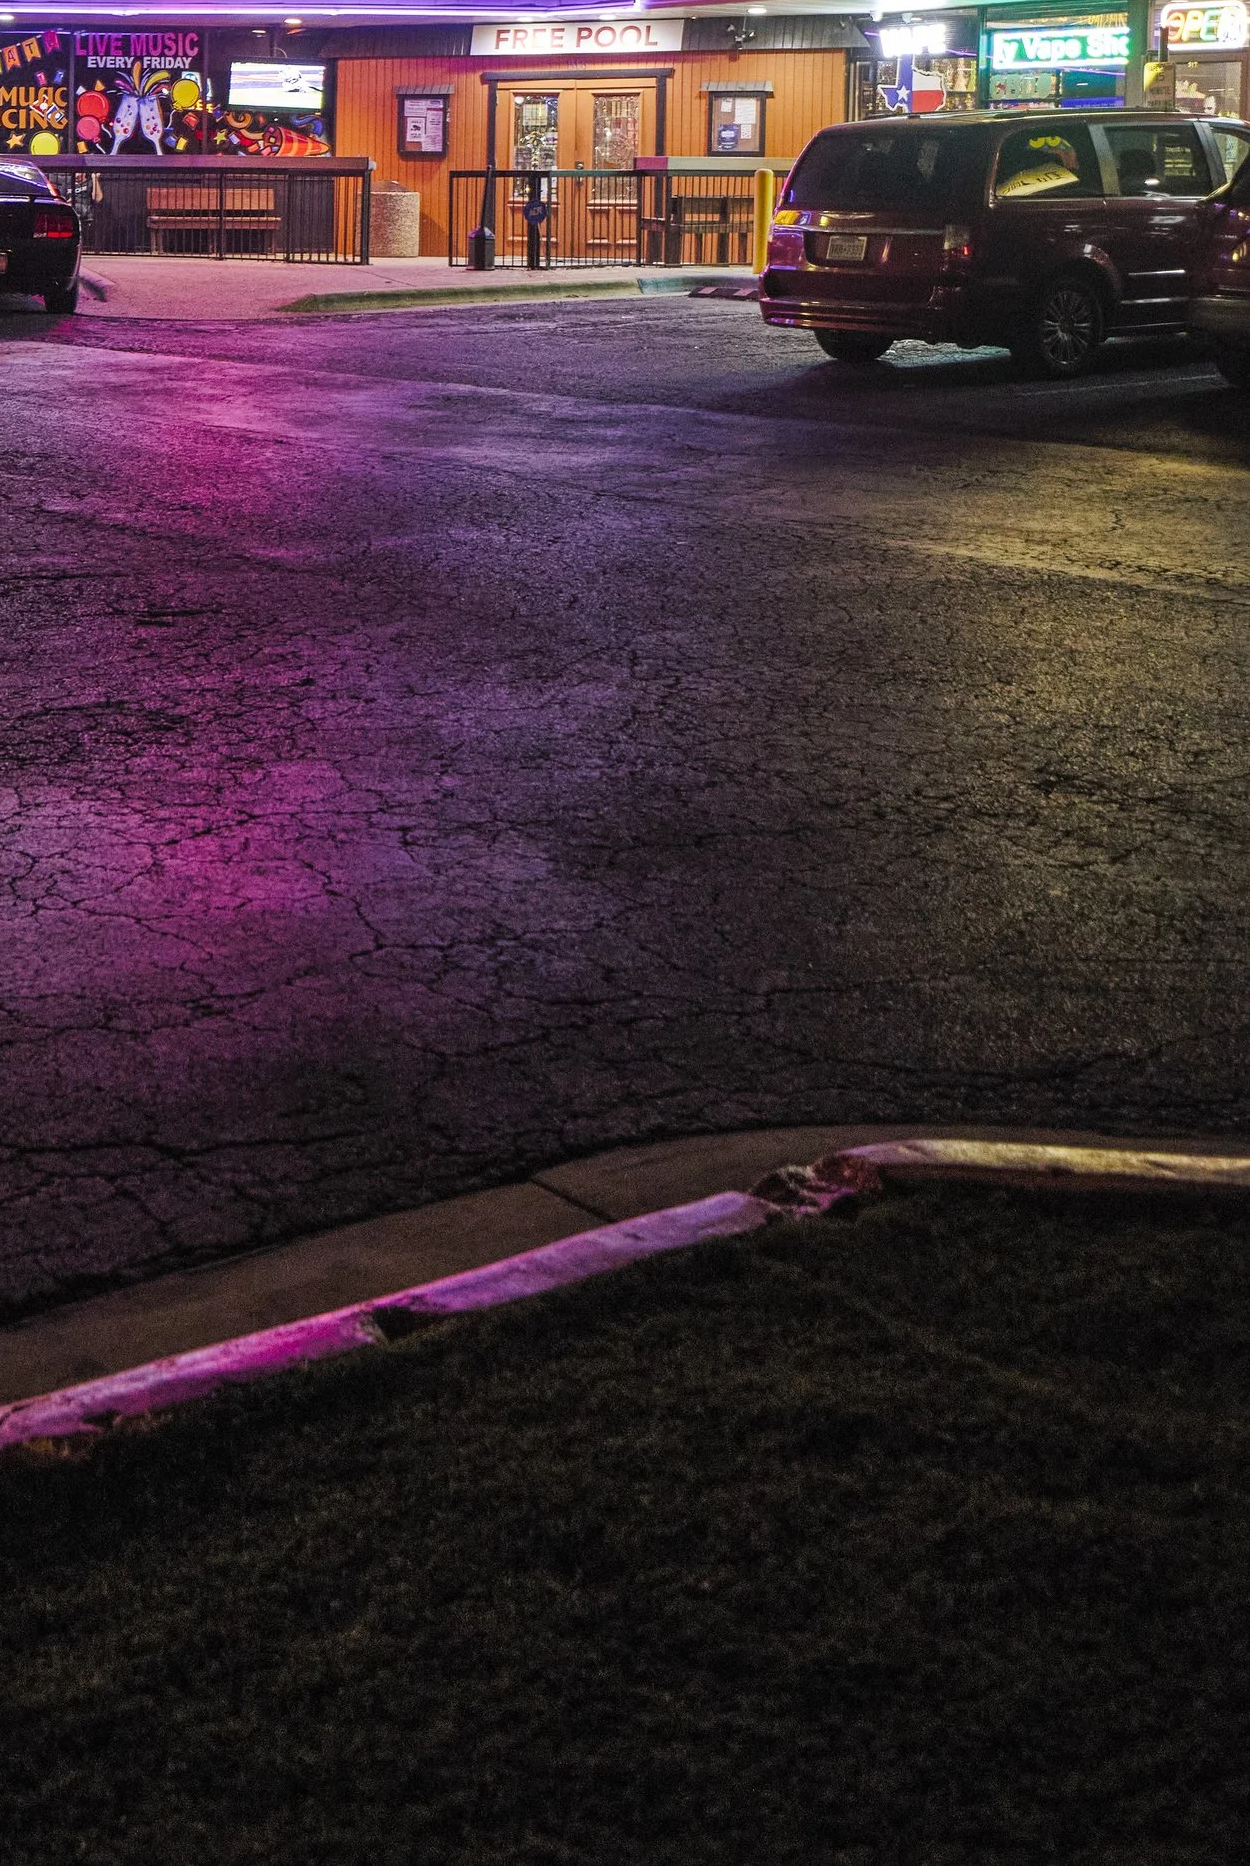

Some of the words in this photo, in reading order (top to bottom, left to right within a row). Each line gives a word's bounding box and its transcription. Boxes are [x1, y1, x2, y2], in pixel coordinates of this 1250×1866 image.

[75, 33, 123, 56] LIVE
[130, 32, 199, 56] MUSIC
[494, 27, 565, 50] FREE
[575, 25, 658, 48] POOL
[87, 56, 134, 68] EVERY
[143, 56, 193, 69] FRIDAY
[0, 86, 68, 107] MUSIC
